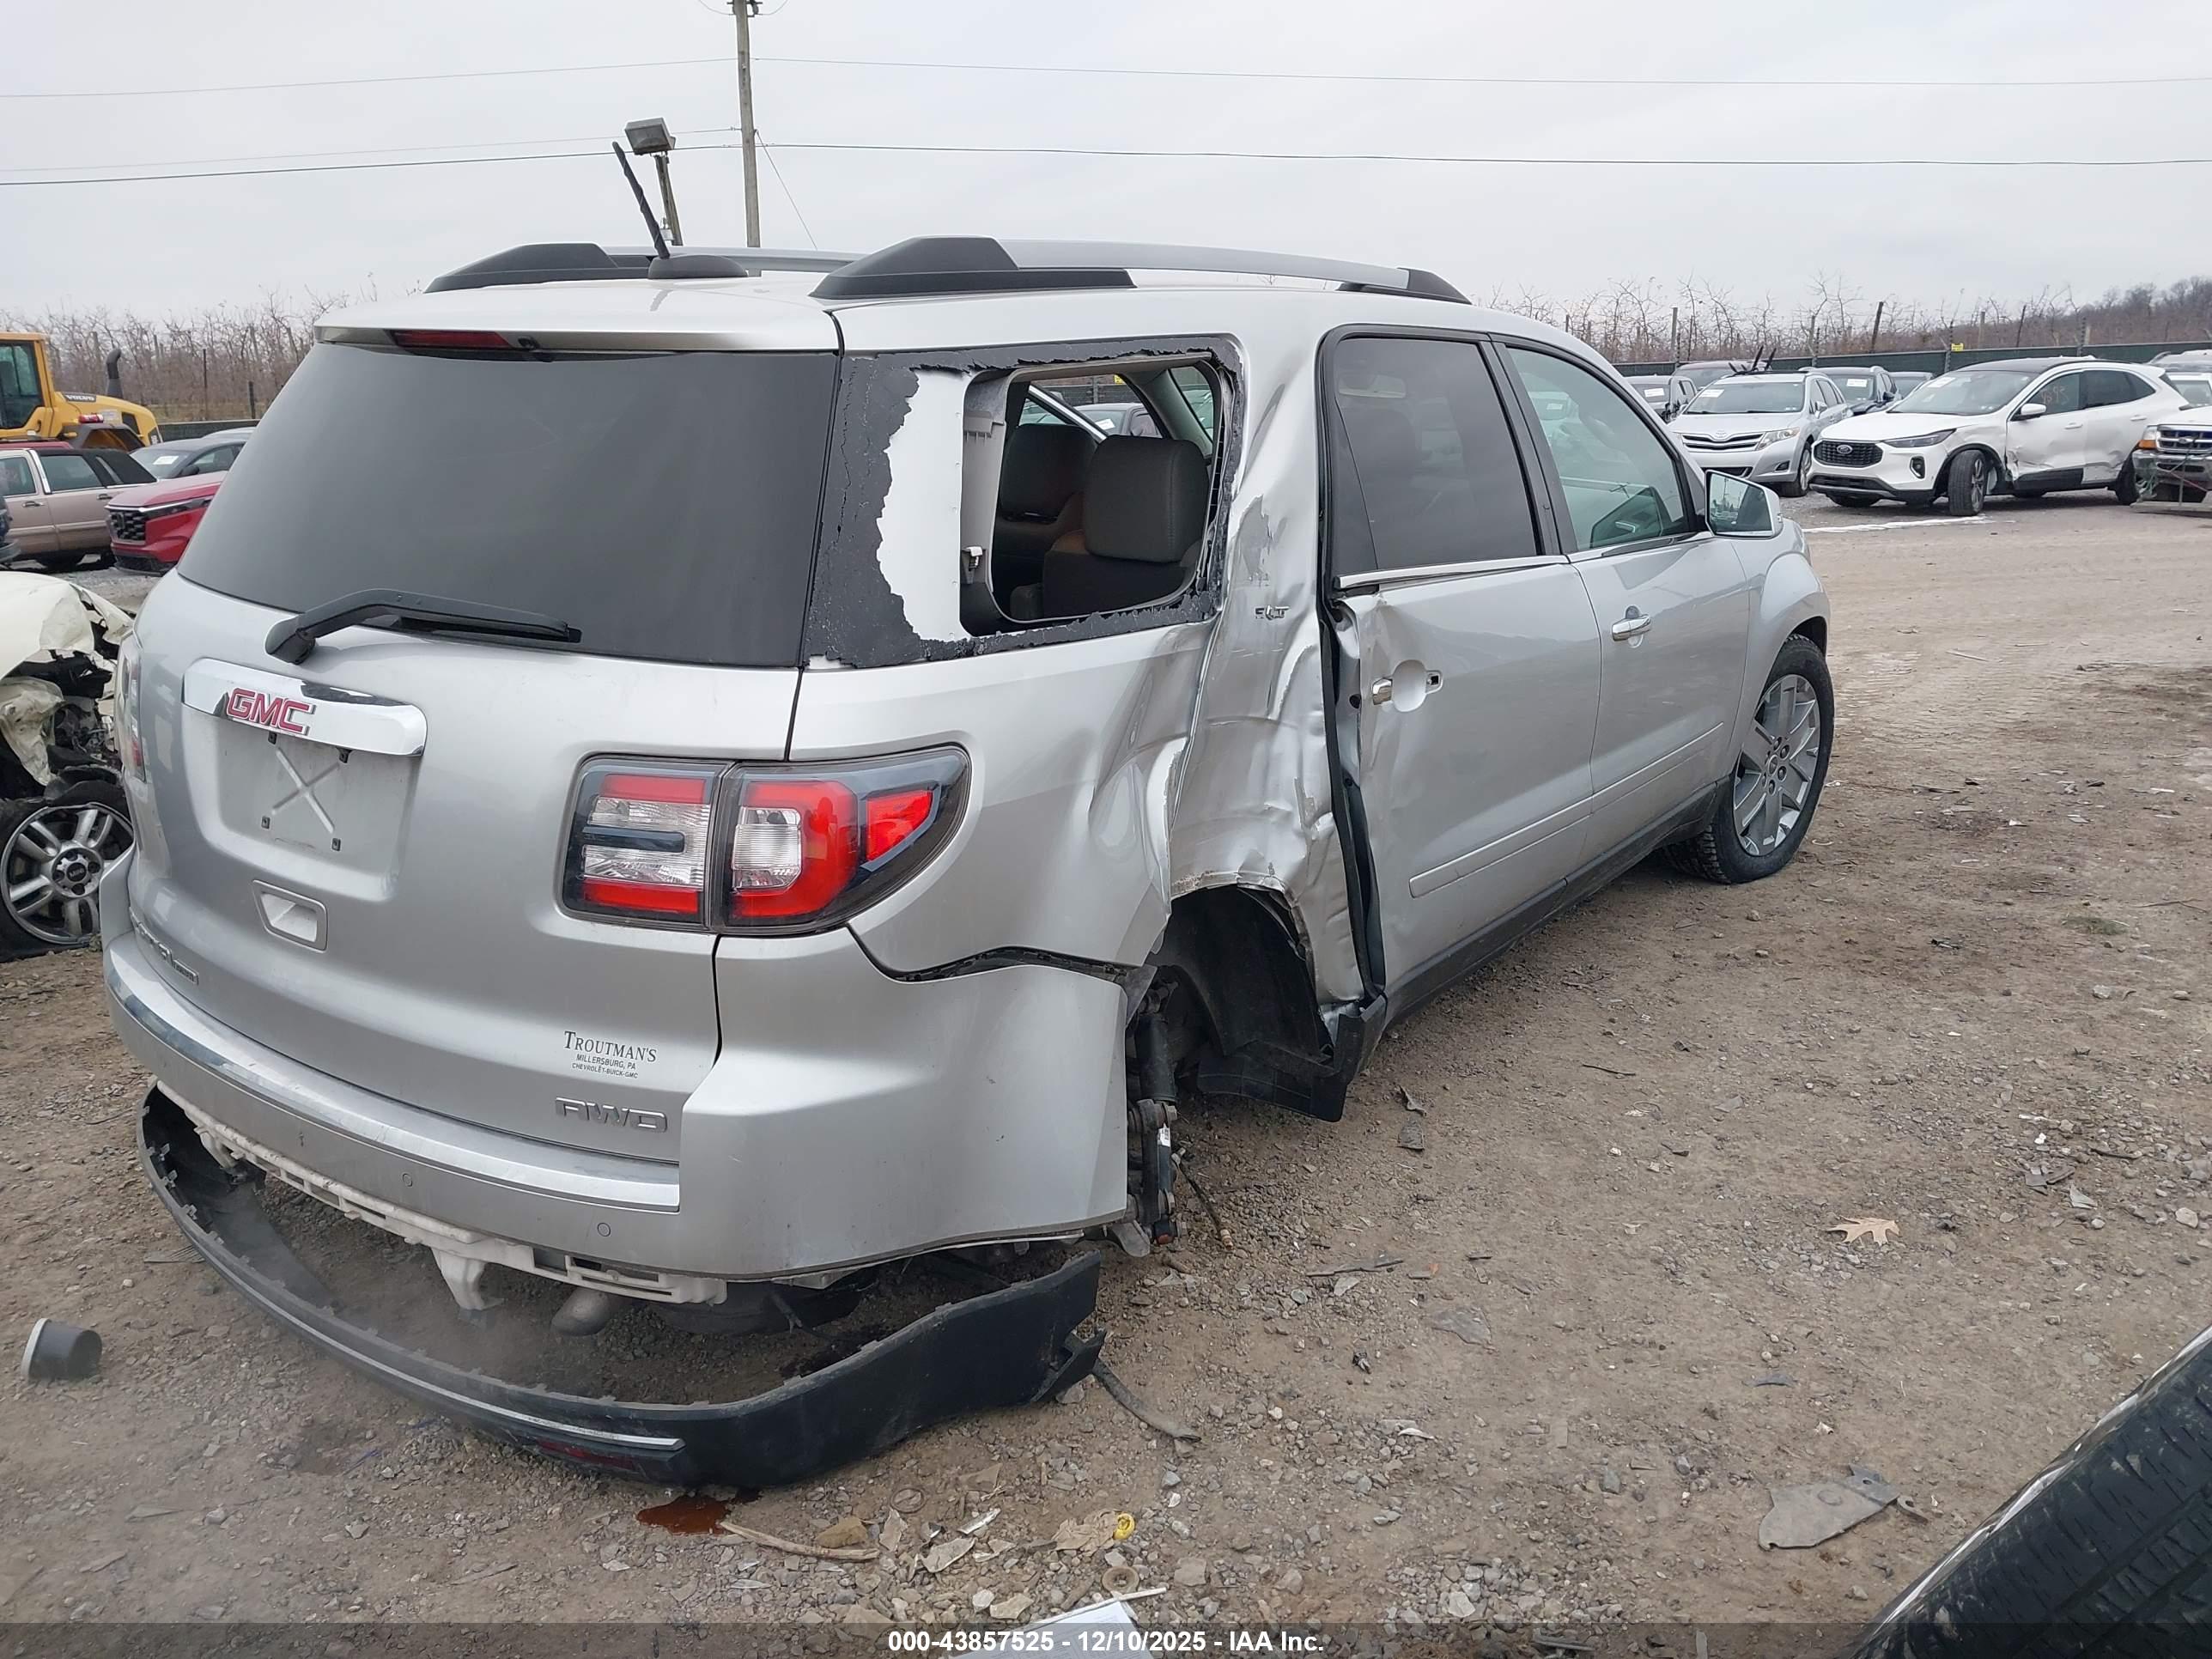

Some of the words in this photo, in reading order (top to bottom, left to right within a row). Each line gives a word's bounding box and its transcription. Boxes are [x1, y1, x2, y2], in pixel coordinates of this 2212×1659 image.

[226, 687, 316, 736] GMC
[563, 1030, 657, 1062] TROUTMAN'S
[576, 1054, 626, 1068] MILLERSBURG,
[627, 1060, 636, 1070] PA
[555, 1097, 668, 1133] AWD
